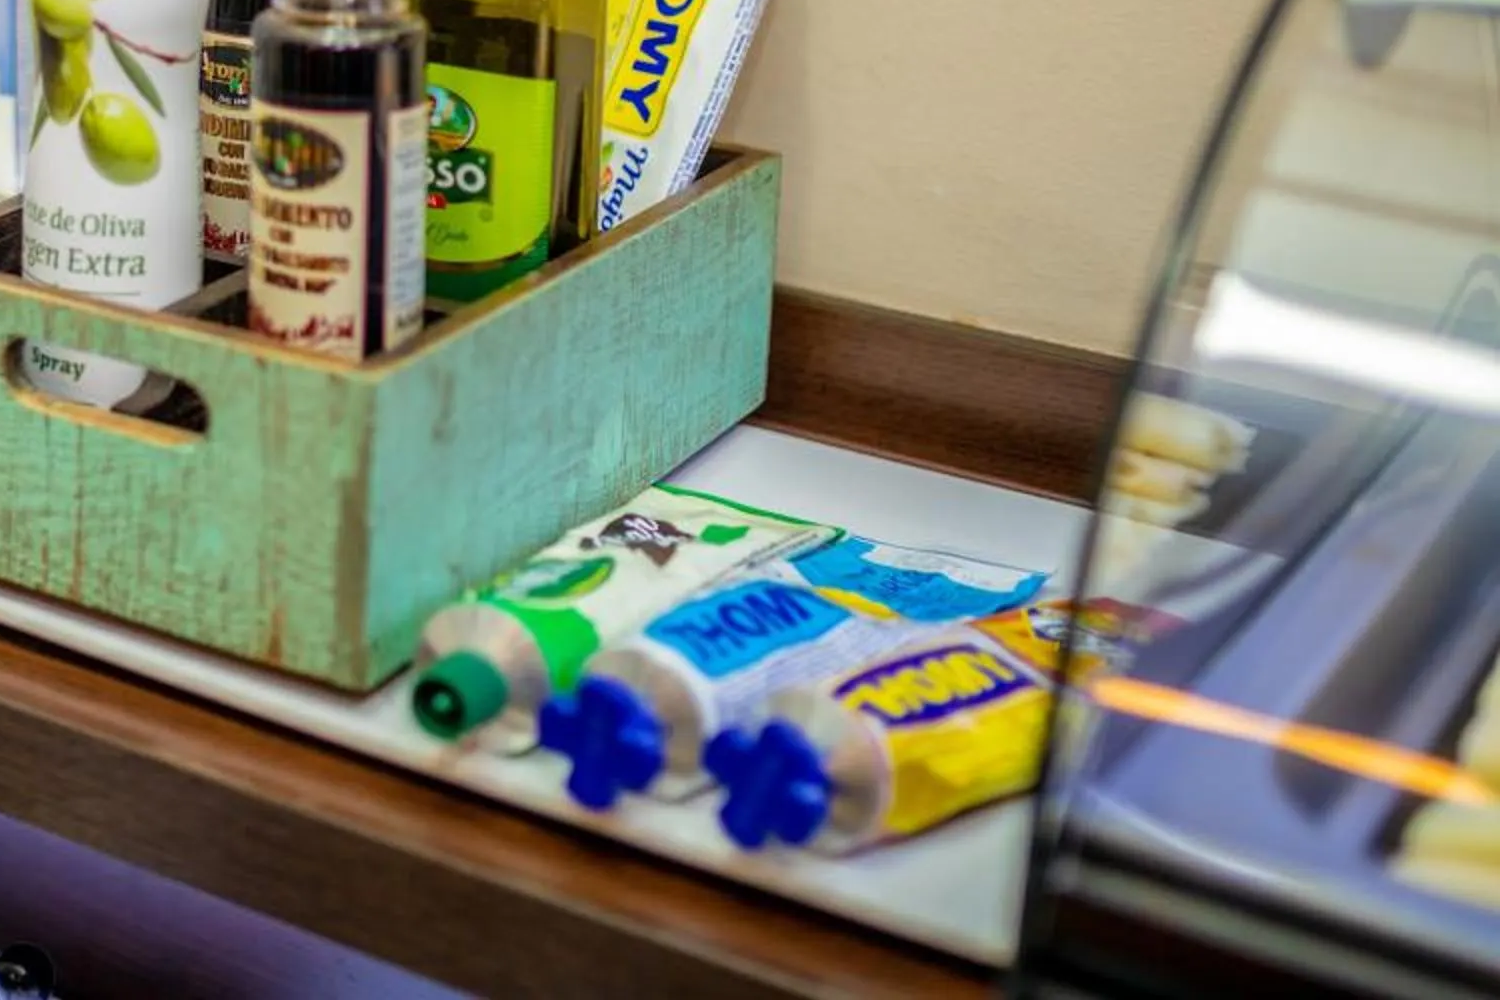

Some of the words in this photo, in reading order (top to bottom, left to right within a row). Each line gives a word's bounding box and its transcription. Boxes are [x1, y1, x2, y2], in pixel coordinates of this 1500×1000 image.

[426, 157, 487, 194] SSO
[50, 206, 76, 233] de
[81, 212, 146, 238] Oliva
[67, 247, 146, 277] Extra
[31, 345, 86, 382] Spray
[660, 582, 814, 662] THOM
